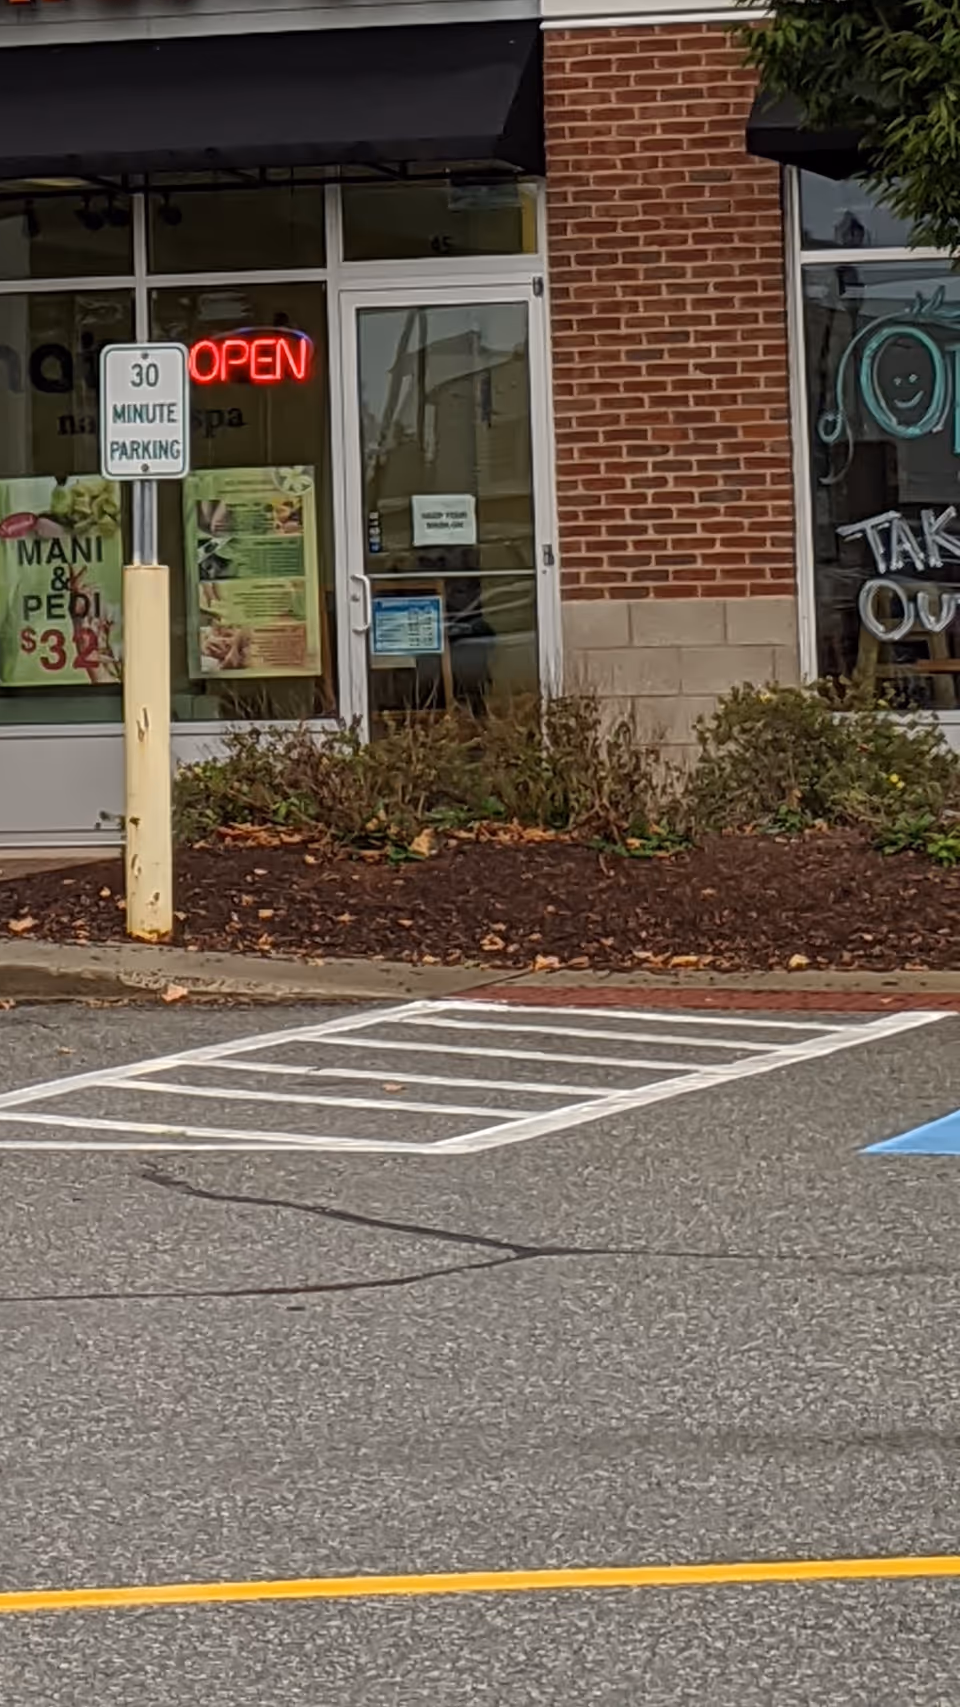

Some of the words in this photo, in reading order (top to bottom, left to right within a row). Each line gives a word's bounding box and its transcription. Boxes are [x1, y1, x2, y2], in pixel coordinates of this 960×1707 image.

[189, 337, 308, 382] OPEN
[130, 363, 159, 388] 30
[112, 402, 178, 424] MINUTE
[109, 440, 181, 461] PARKING
[17, 535, 103, 566] MANI
[50, 566, 72, 591] &
[22, 592, 101, 621] PEDI
[858, 579, 960, 641] OU
[20, 626, 100, 671] $32
